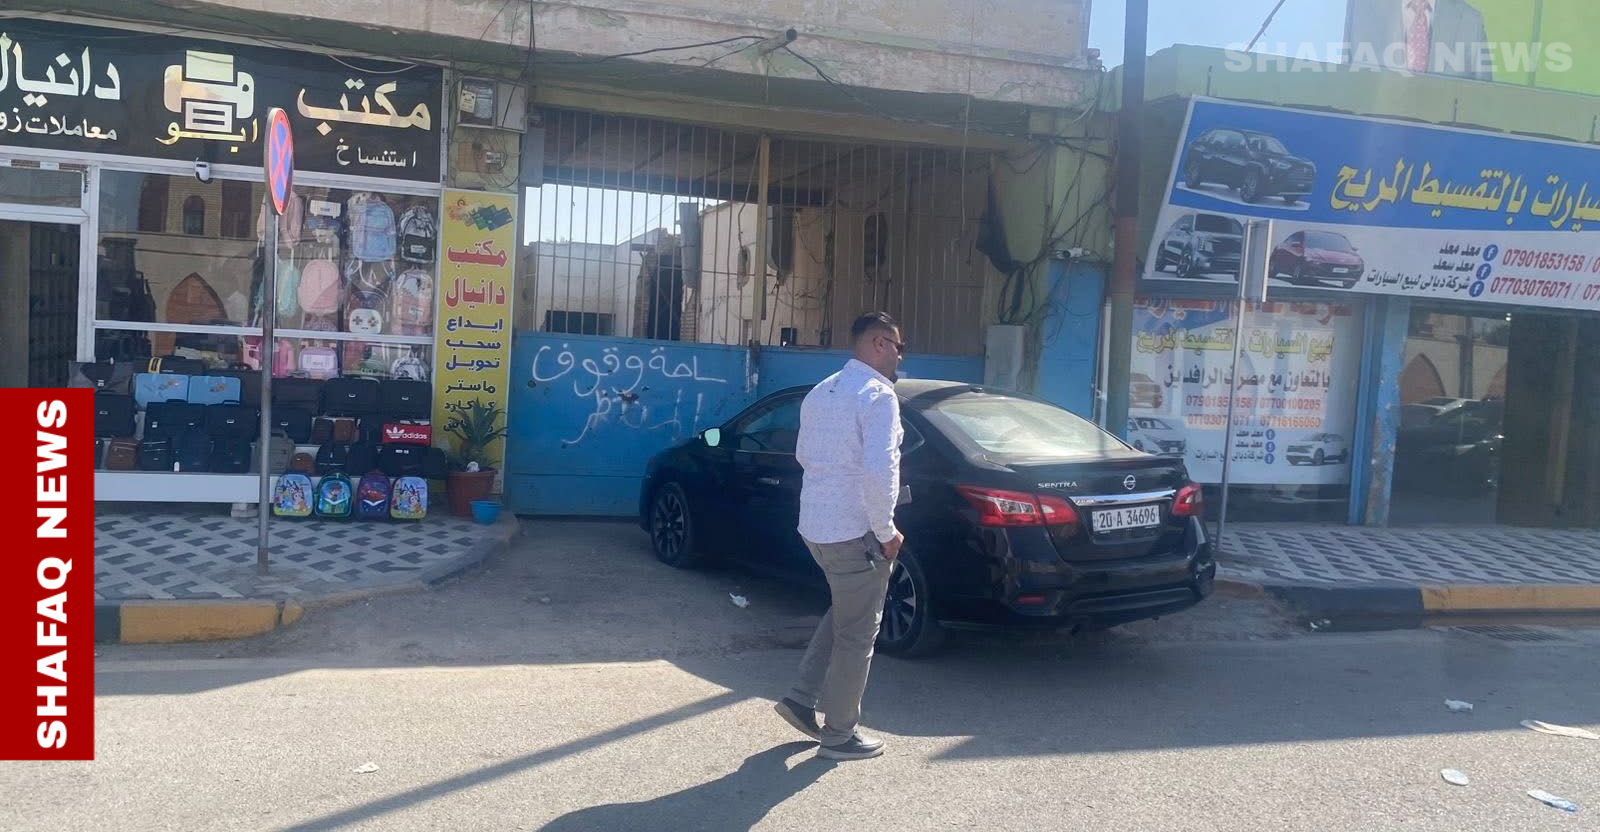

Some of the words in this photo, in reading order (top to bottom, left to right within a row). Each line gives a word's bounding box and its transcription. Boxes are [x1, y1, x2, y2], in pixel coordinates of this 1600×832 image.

[297, 77, 432, 137] مكتب
[25, 115, 117, 140] معاملات
[155, 118, 259, 153] ابو
[1330, 157, 1415, 213] المريح
[1411, 161, 1528, 226] بالتقسيط
[447, 240, 507, 269] مكتب
[1502, 248, 1586, 272] 07901853158
[1367, 269, 1404, 287] السيارات
[1446, 276, 1470, 293] شركة
[1490, 276, 1572, 299] 07703076071
[445, 277, 506, 309] دانيال
[446, 316, 503, 331] ايداع
[446, 338, 501, 350] سحب
[445, 355, 500, 371] تحويل
[532, 343, 644, 397] وقوف
[649, 346, 728, 384] ساحة
[445, 379, 496, 393] ماستر
[1266, 373, 1282, 393] مع
[1099, 512, 1113, 528] 20
[1117, 511, 1123, 527] A
[1126, 507, 1156, 526] 34696
